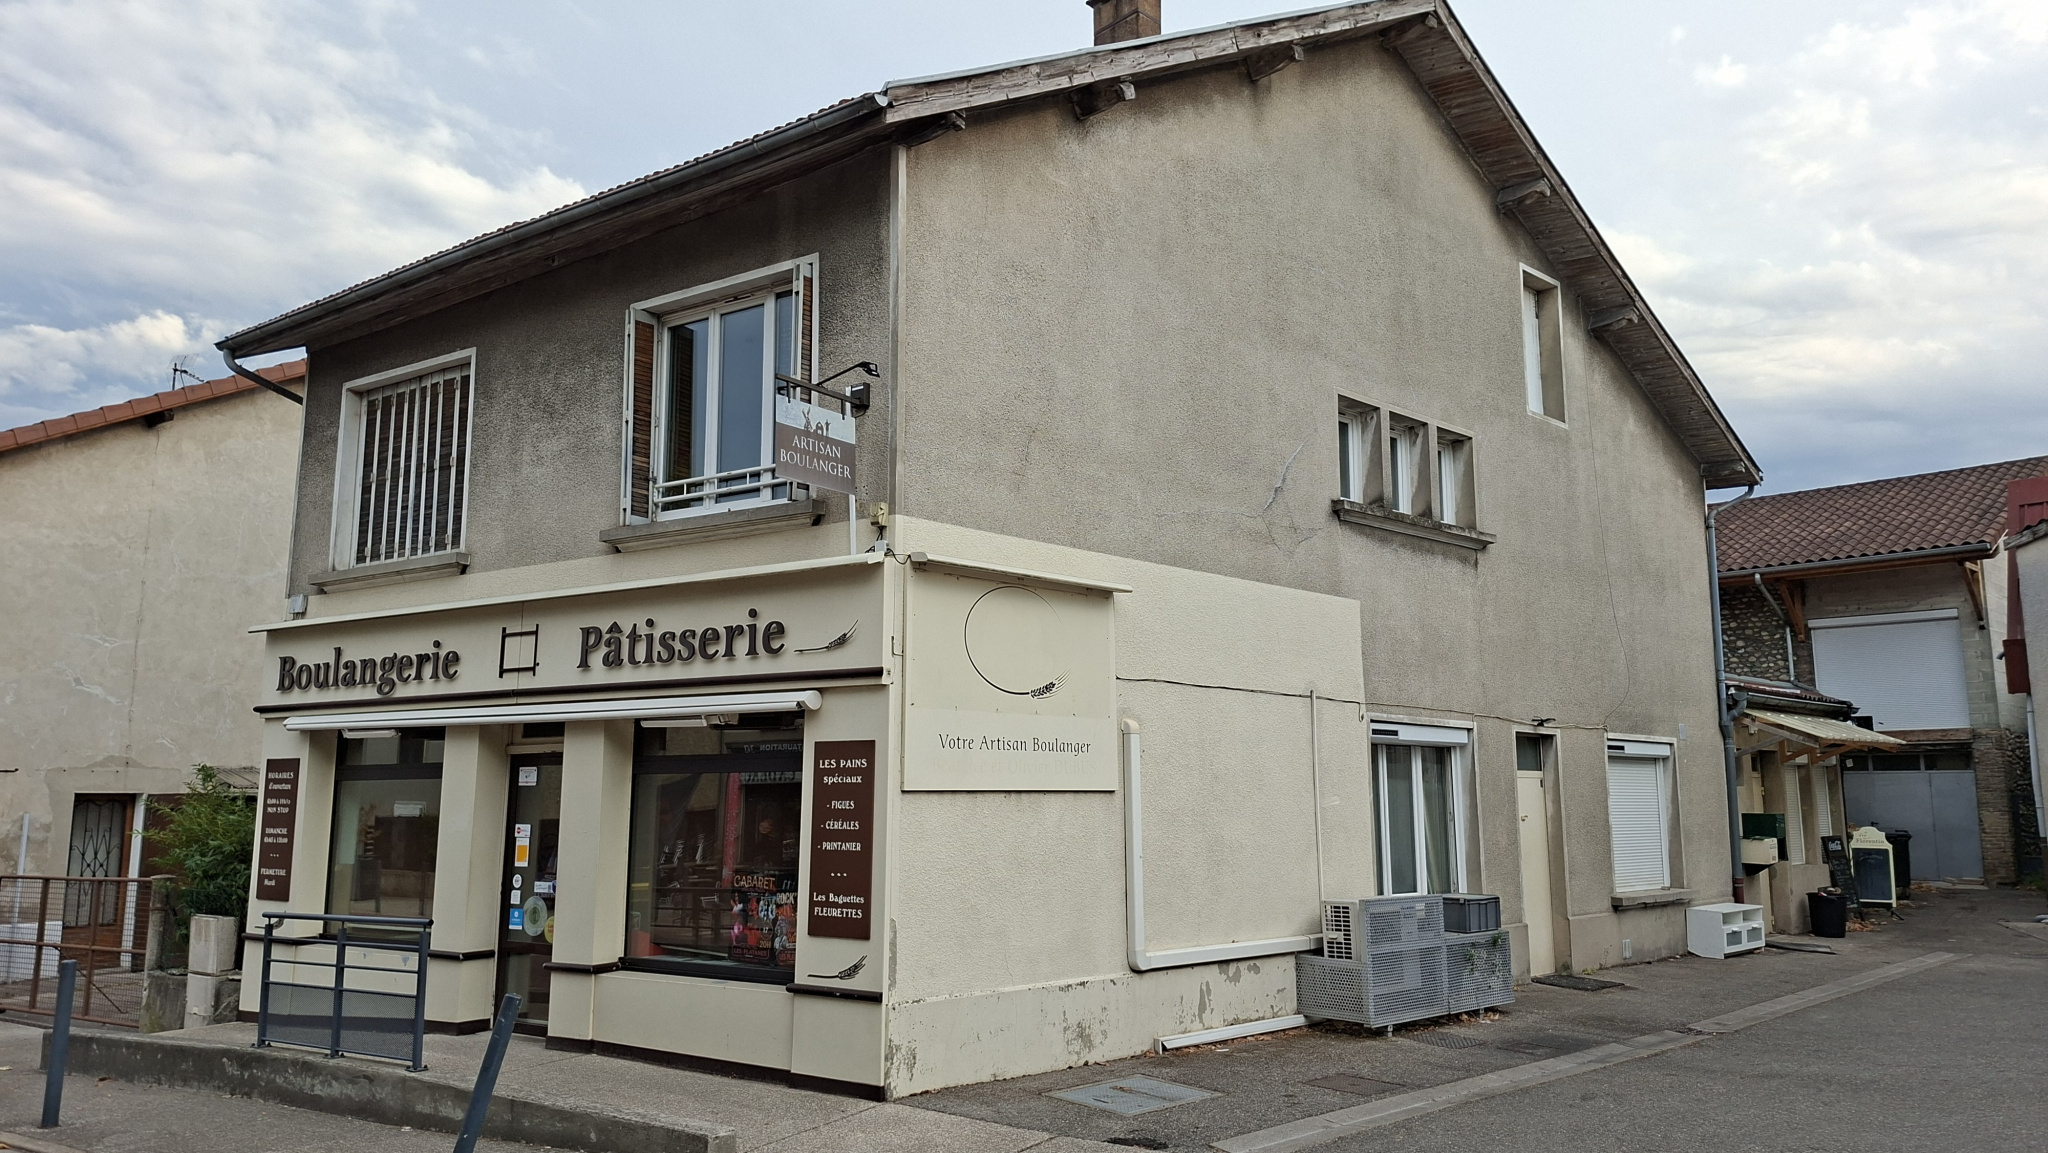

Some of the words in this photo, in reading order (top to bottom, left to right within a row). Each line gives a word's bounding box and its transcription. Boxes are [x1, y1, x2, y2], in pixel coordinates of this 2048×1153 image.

[792, 435, 841, 459] ARTISAN
[780, 448, 852, 479] BOULANGER
[276, 640, 460, 696] Boulangerie
[577, 608, 785, 669] Pâtisserie
[938, 733, 974, 750] Votre
[979, 735, 1028, 752] Artisan
[1032, 737, 1092, 757] Boulanger
[819, 759, 837, 769] LES
[840, 758, 868, 769] PAINS
[823, 773, 863, 785] spéciaux
[831, 800, 855, 810] FIGUES
[825, 818, 860, 830] CÉRÉALES
[822, 841, 861, 852] PRINTANIER
[733, 875, 776, 890] CABARET
[813, 892, 826, 902] Les
[829, 892, 865, 905] Baguettes
[814, 906, 863, 919] FLEURETTES
